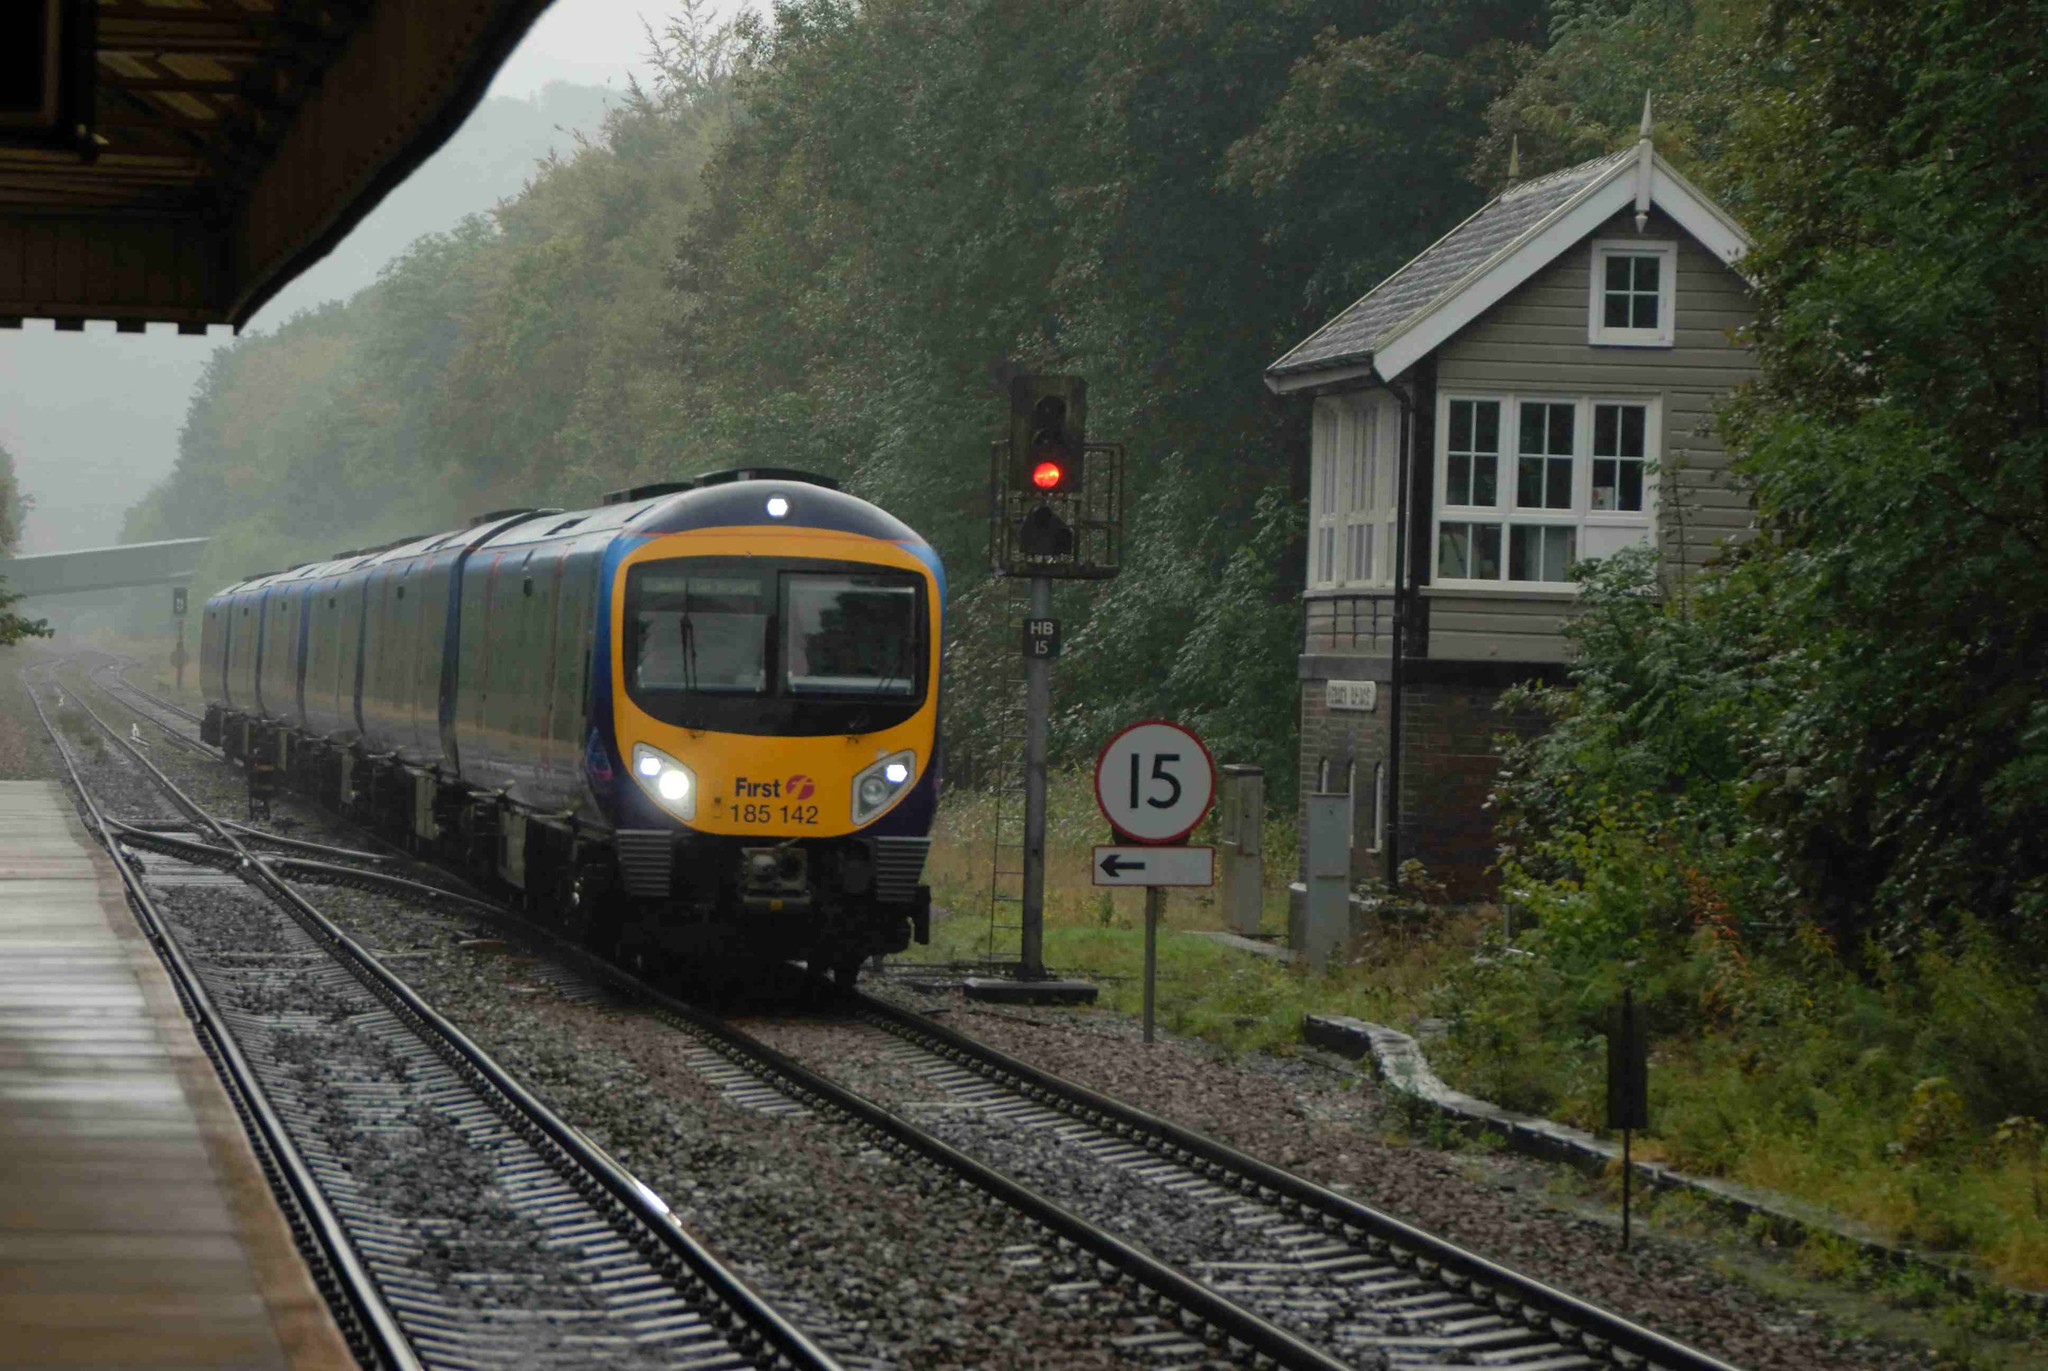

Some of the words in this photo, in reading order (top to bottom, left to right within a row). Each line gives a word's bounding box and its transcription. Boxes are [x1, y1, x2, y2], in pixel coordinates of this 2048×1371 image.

[1030, 621, 1054, 635] HB
[1035, 640, 1049, 655] 15
[735, 777, 781, 797] First
[1130, 753, 1182, 809] 15
[730, 803, 771, 823] 185
[779, 805, 818, 824] 142
